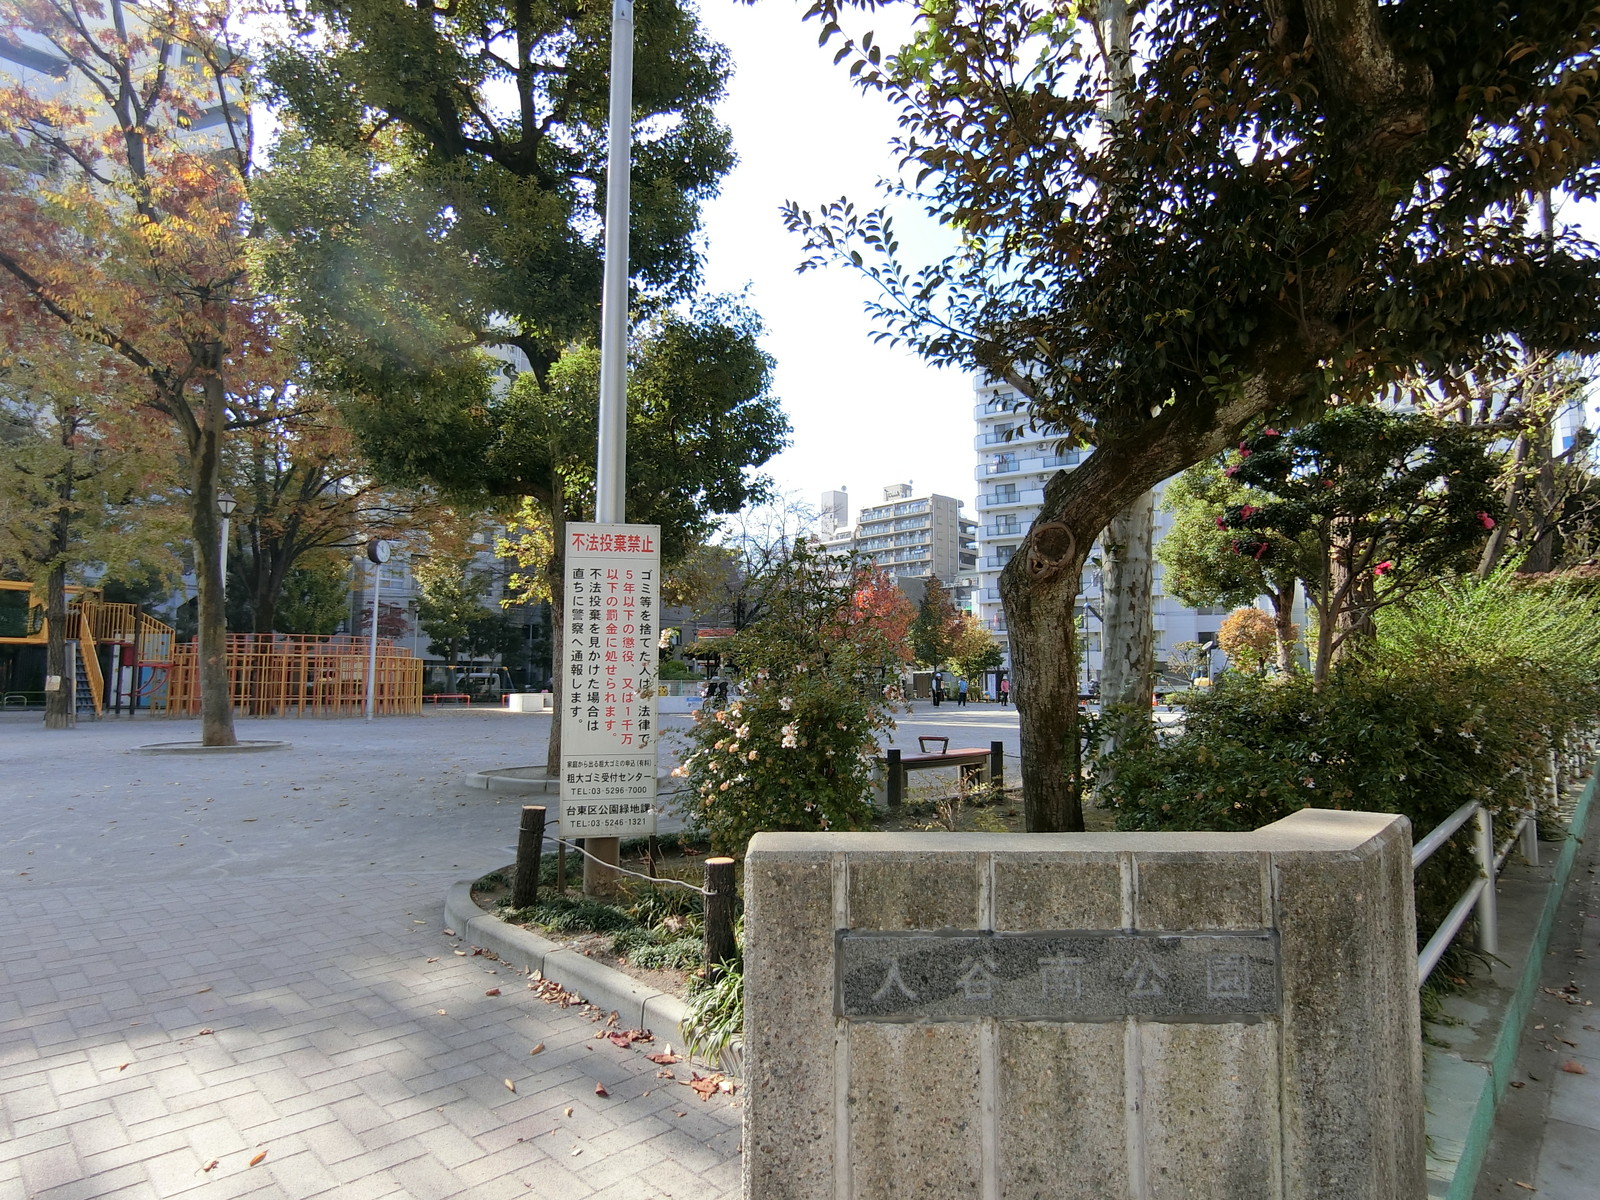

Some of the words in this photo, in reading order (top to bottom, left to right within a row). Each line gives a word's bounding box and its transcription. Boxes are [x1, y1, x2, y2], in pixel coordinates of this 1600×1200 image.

[572, 533, 654, 553] 不法投棄禁止
[570, 567, 584, 723] 直ちに警察へ通報します。
[587, 568, 602, 731] 不法投棄を見かけた場合は
[605, 568, 618, 736] 以下の罰金に処せられます。
[638, 569, 652, 745] ゴミ等を捨てた人は法律で
[566, 803, 651, 816] 台東区公園緑地課
[567, 772, 651, 783] 粗大ゴミ受付センター
[872, 951, 1251, 1002] 入谷南公園
